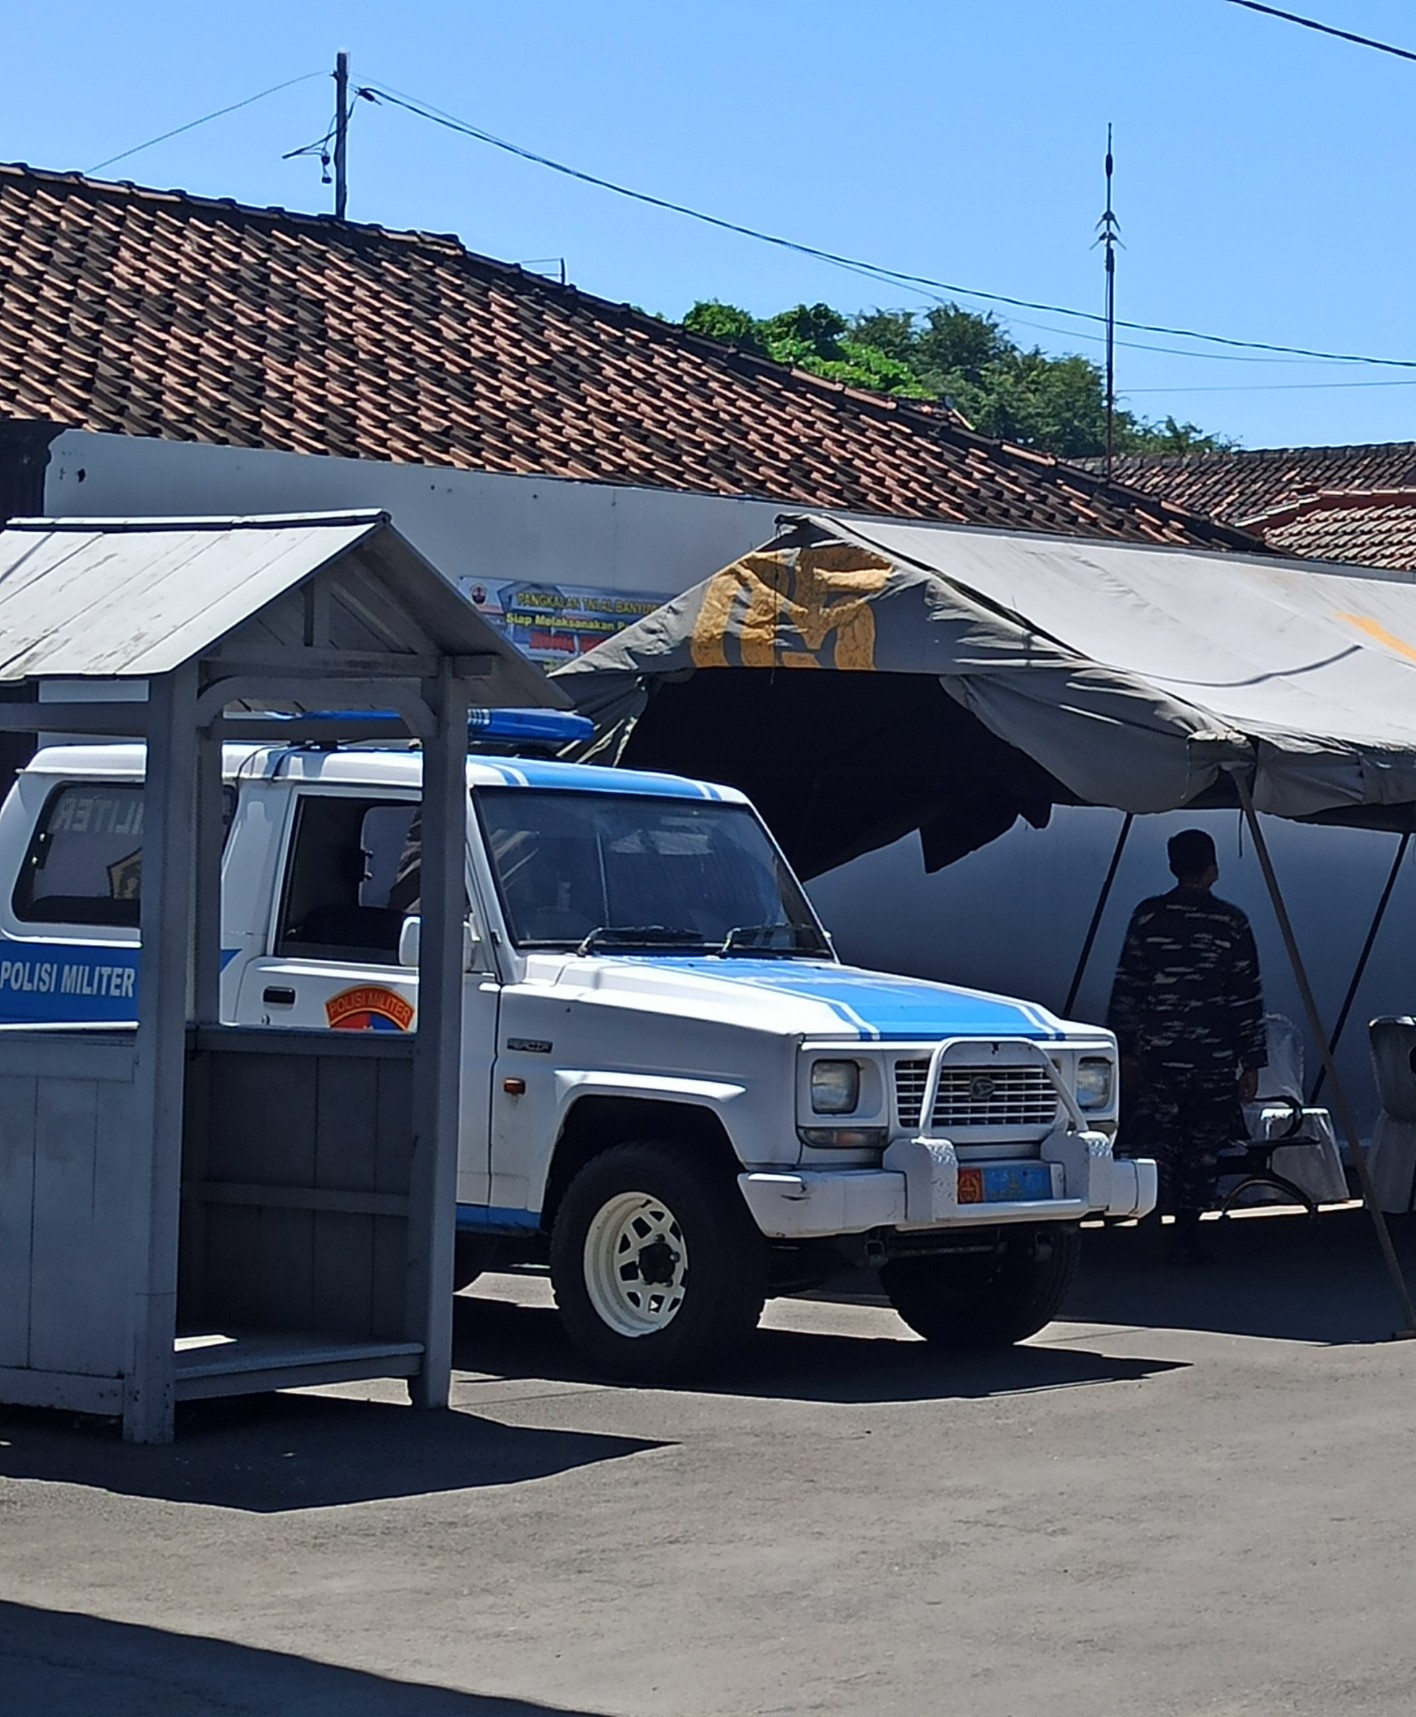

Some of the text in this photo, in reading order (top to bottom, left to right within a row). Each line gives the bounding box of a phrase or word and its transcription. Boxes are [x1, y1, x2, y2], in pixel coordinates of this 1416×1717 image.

[506, 612, 532, 626] Siap
[535, 614, 614, 631] Melaksanakan
[0, 960, 136, 998] POLISI MILITER
[328, 992, 412, 1025] POLISI MILITER
